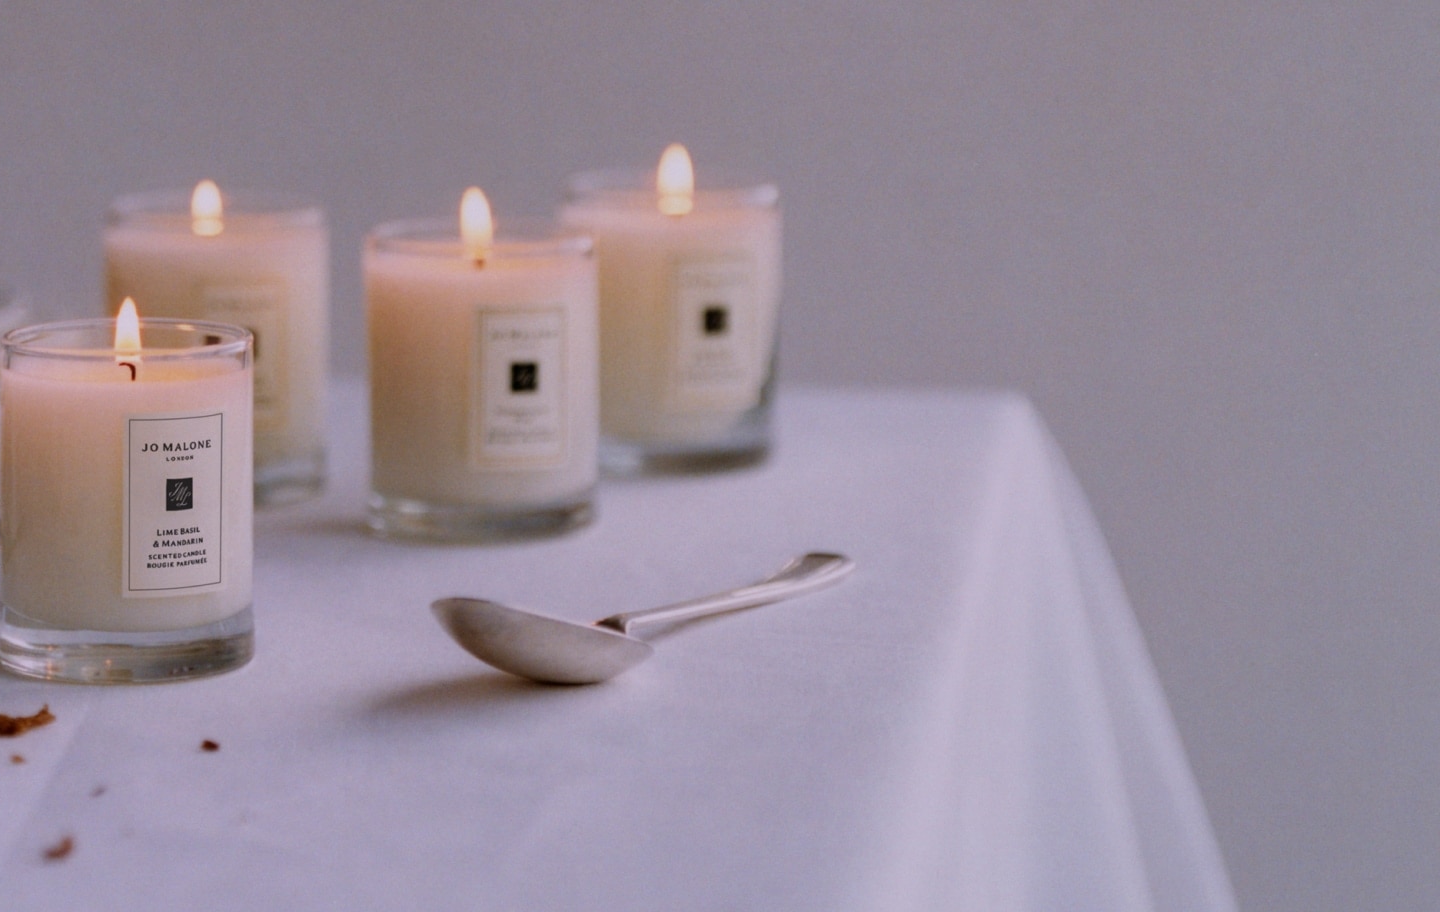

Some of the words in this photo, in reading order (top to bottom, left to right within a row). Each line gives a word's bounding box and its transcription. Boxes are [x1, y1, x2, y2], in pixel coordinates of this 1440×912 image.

[141, 443, 159, 452] JO
[162, 439, 212, 452] MALONE
[156, 529, 179, 537] LIME
[180, 526, 200, 535] BASIL
[152, 540, 160, 548] &
[162, 537, 204, 547] MANDARIN
[183, 549, 206, 558] CANDLE
